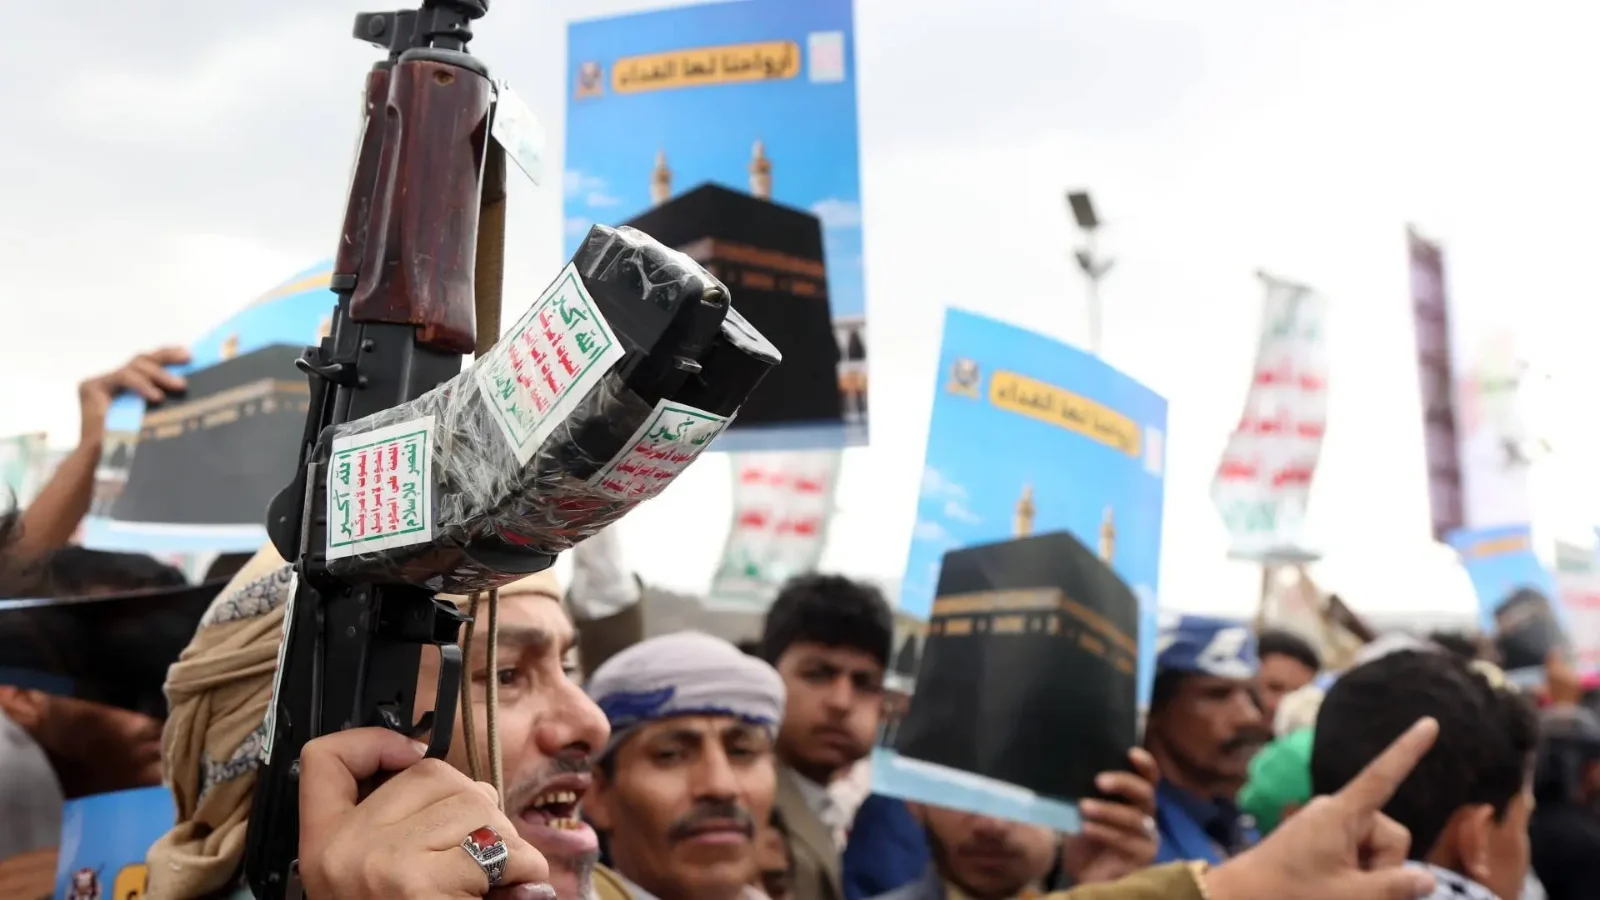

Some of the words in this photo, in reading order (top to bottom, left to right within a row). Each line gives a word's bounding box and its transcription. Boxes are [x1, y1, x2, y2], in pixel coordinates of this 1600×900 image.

[336, 453, 350, 485] الله
[357, 450, 367, 487] الموت
[373, 446, 383, 484] الموت
[386, 442, 399, 471] اللعنة
[401, 438, 420, 476] النصر
[334, 490, 353, 539] أكبر
